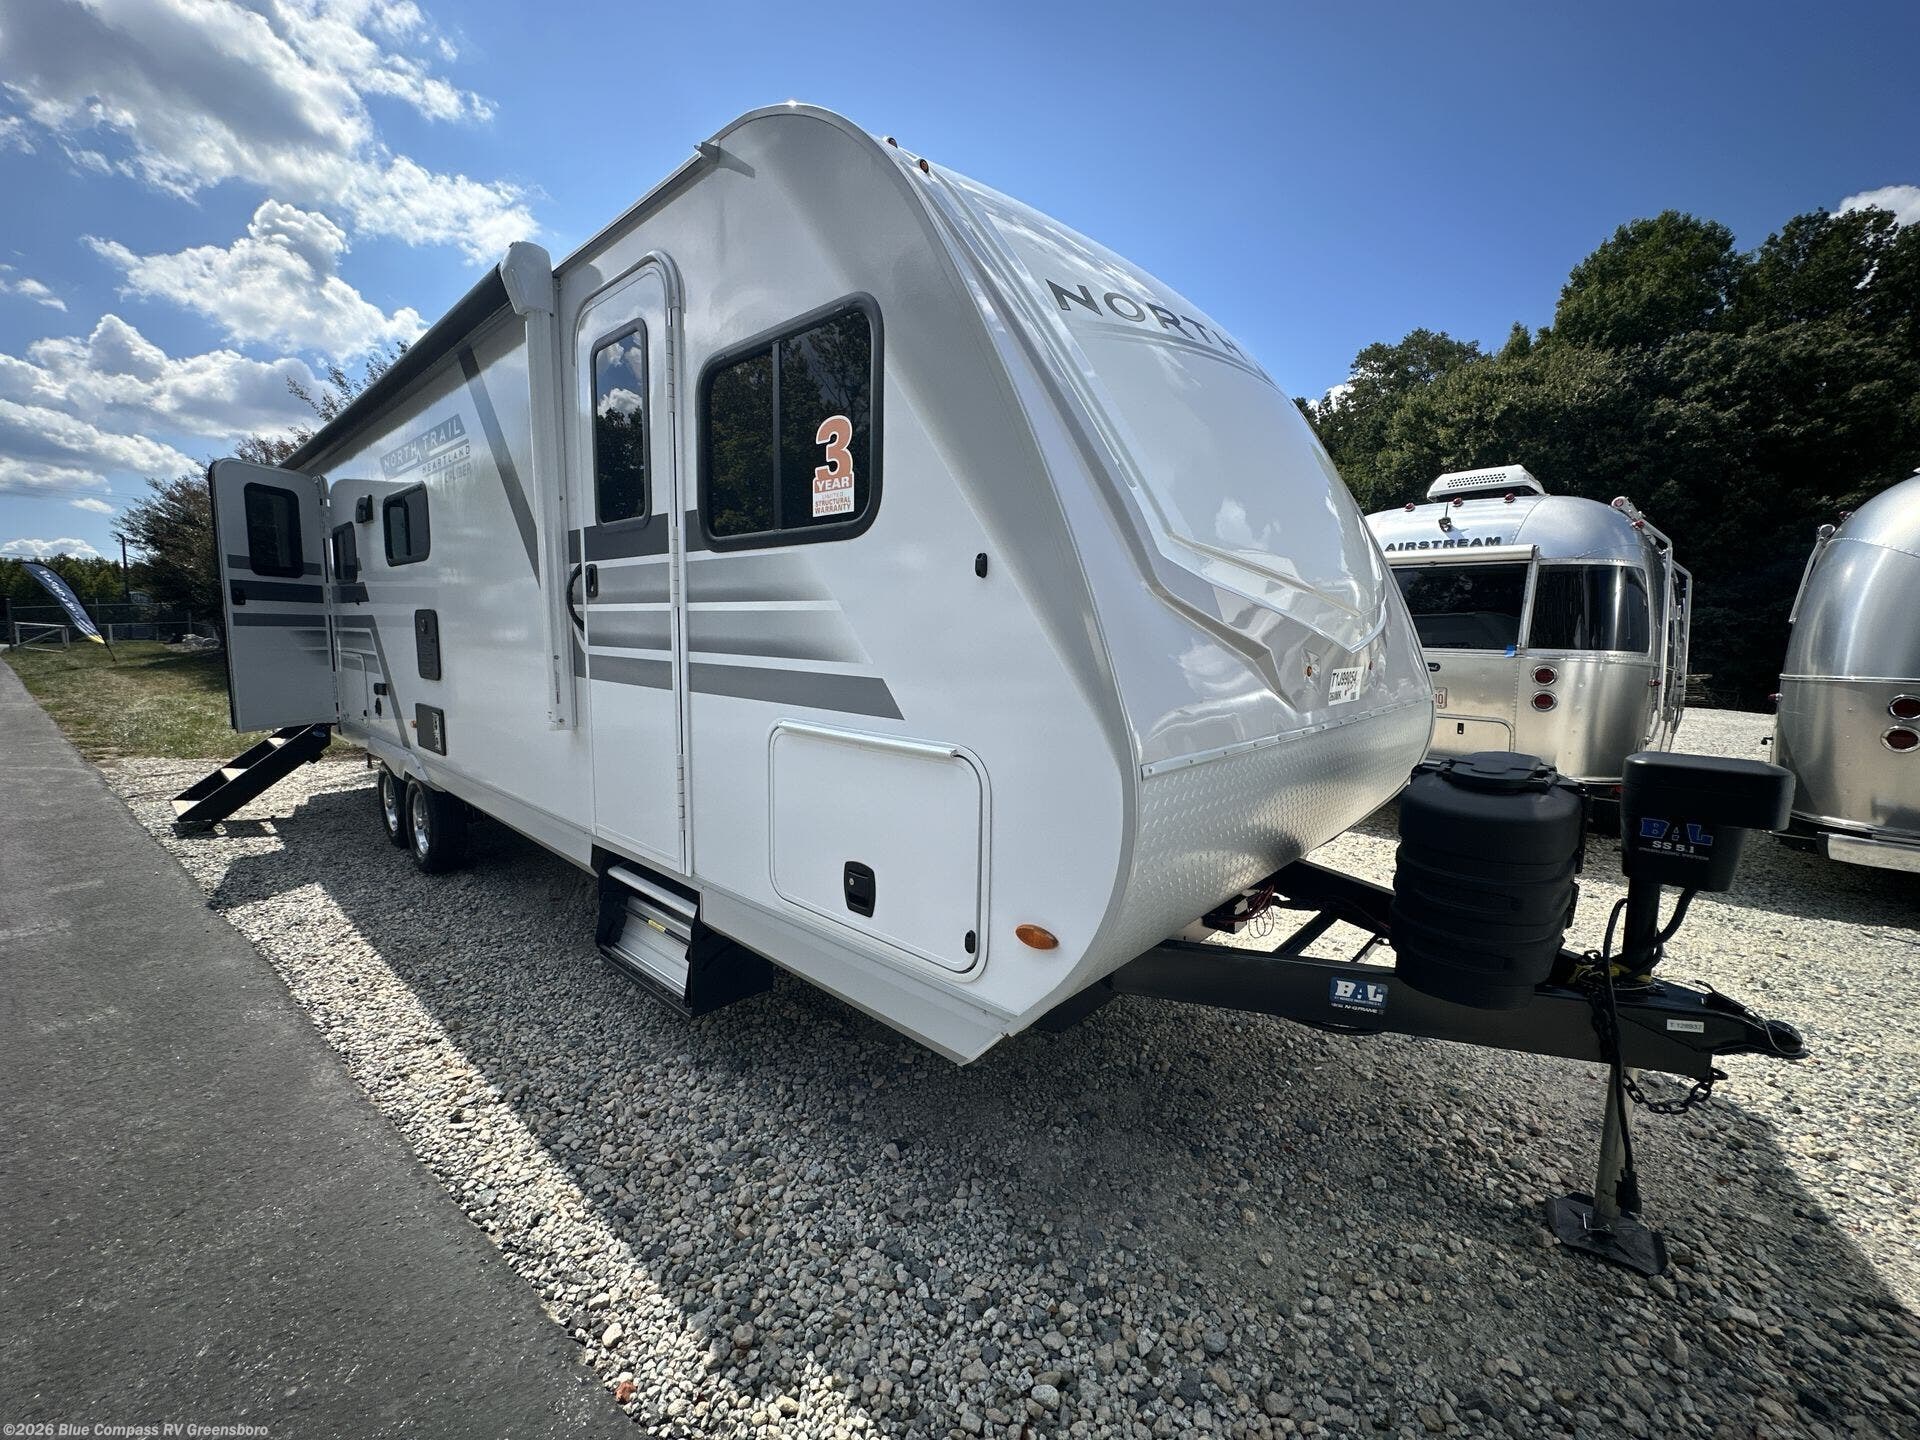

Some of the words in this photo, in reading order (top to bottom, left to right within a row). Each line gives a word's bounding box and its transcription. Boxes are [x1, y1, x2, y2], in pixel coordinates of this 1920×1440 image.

[1045, 278, 1248, 362] NORTH
[384, 440, 418, 473] NORTH
[422, 418, 461, 451] TRAIL
[815, 415, 853, 480] 3
[421, 444, 471, 474] HEARTLAND
[816, 476, 850, 492] YEAR
[815, 497, 851, 508] STRUCTURAL
[815, 503, 851, 515] WARRANTY
[1384, 536, 1502, 552] AIRSTREAM
[1640, 817, 1714, 846] BAL
[1335, 980, 1384, 1003] BAL
